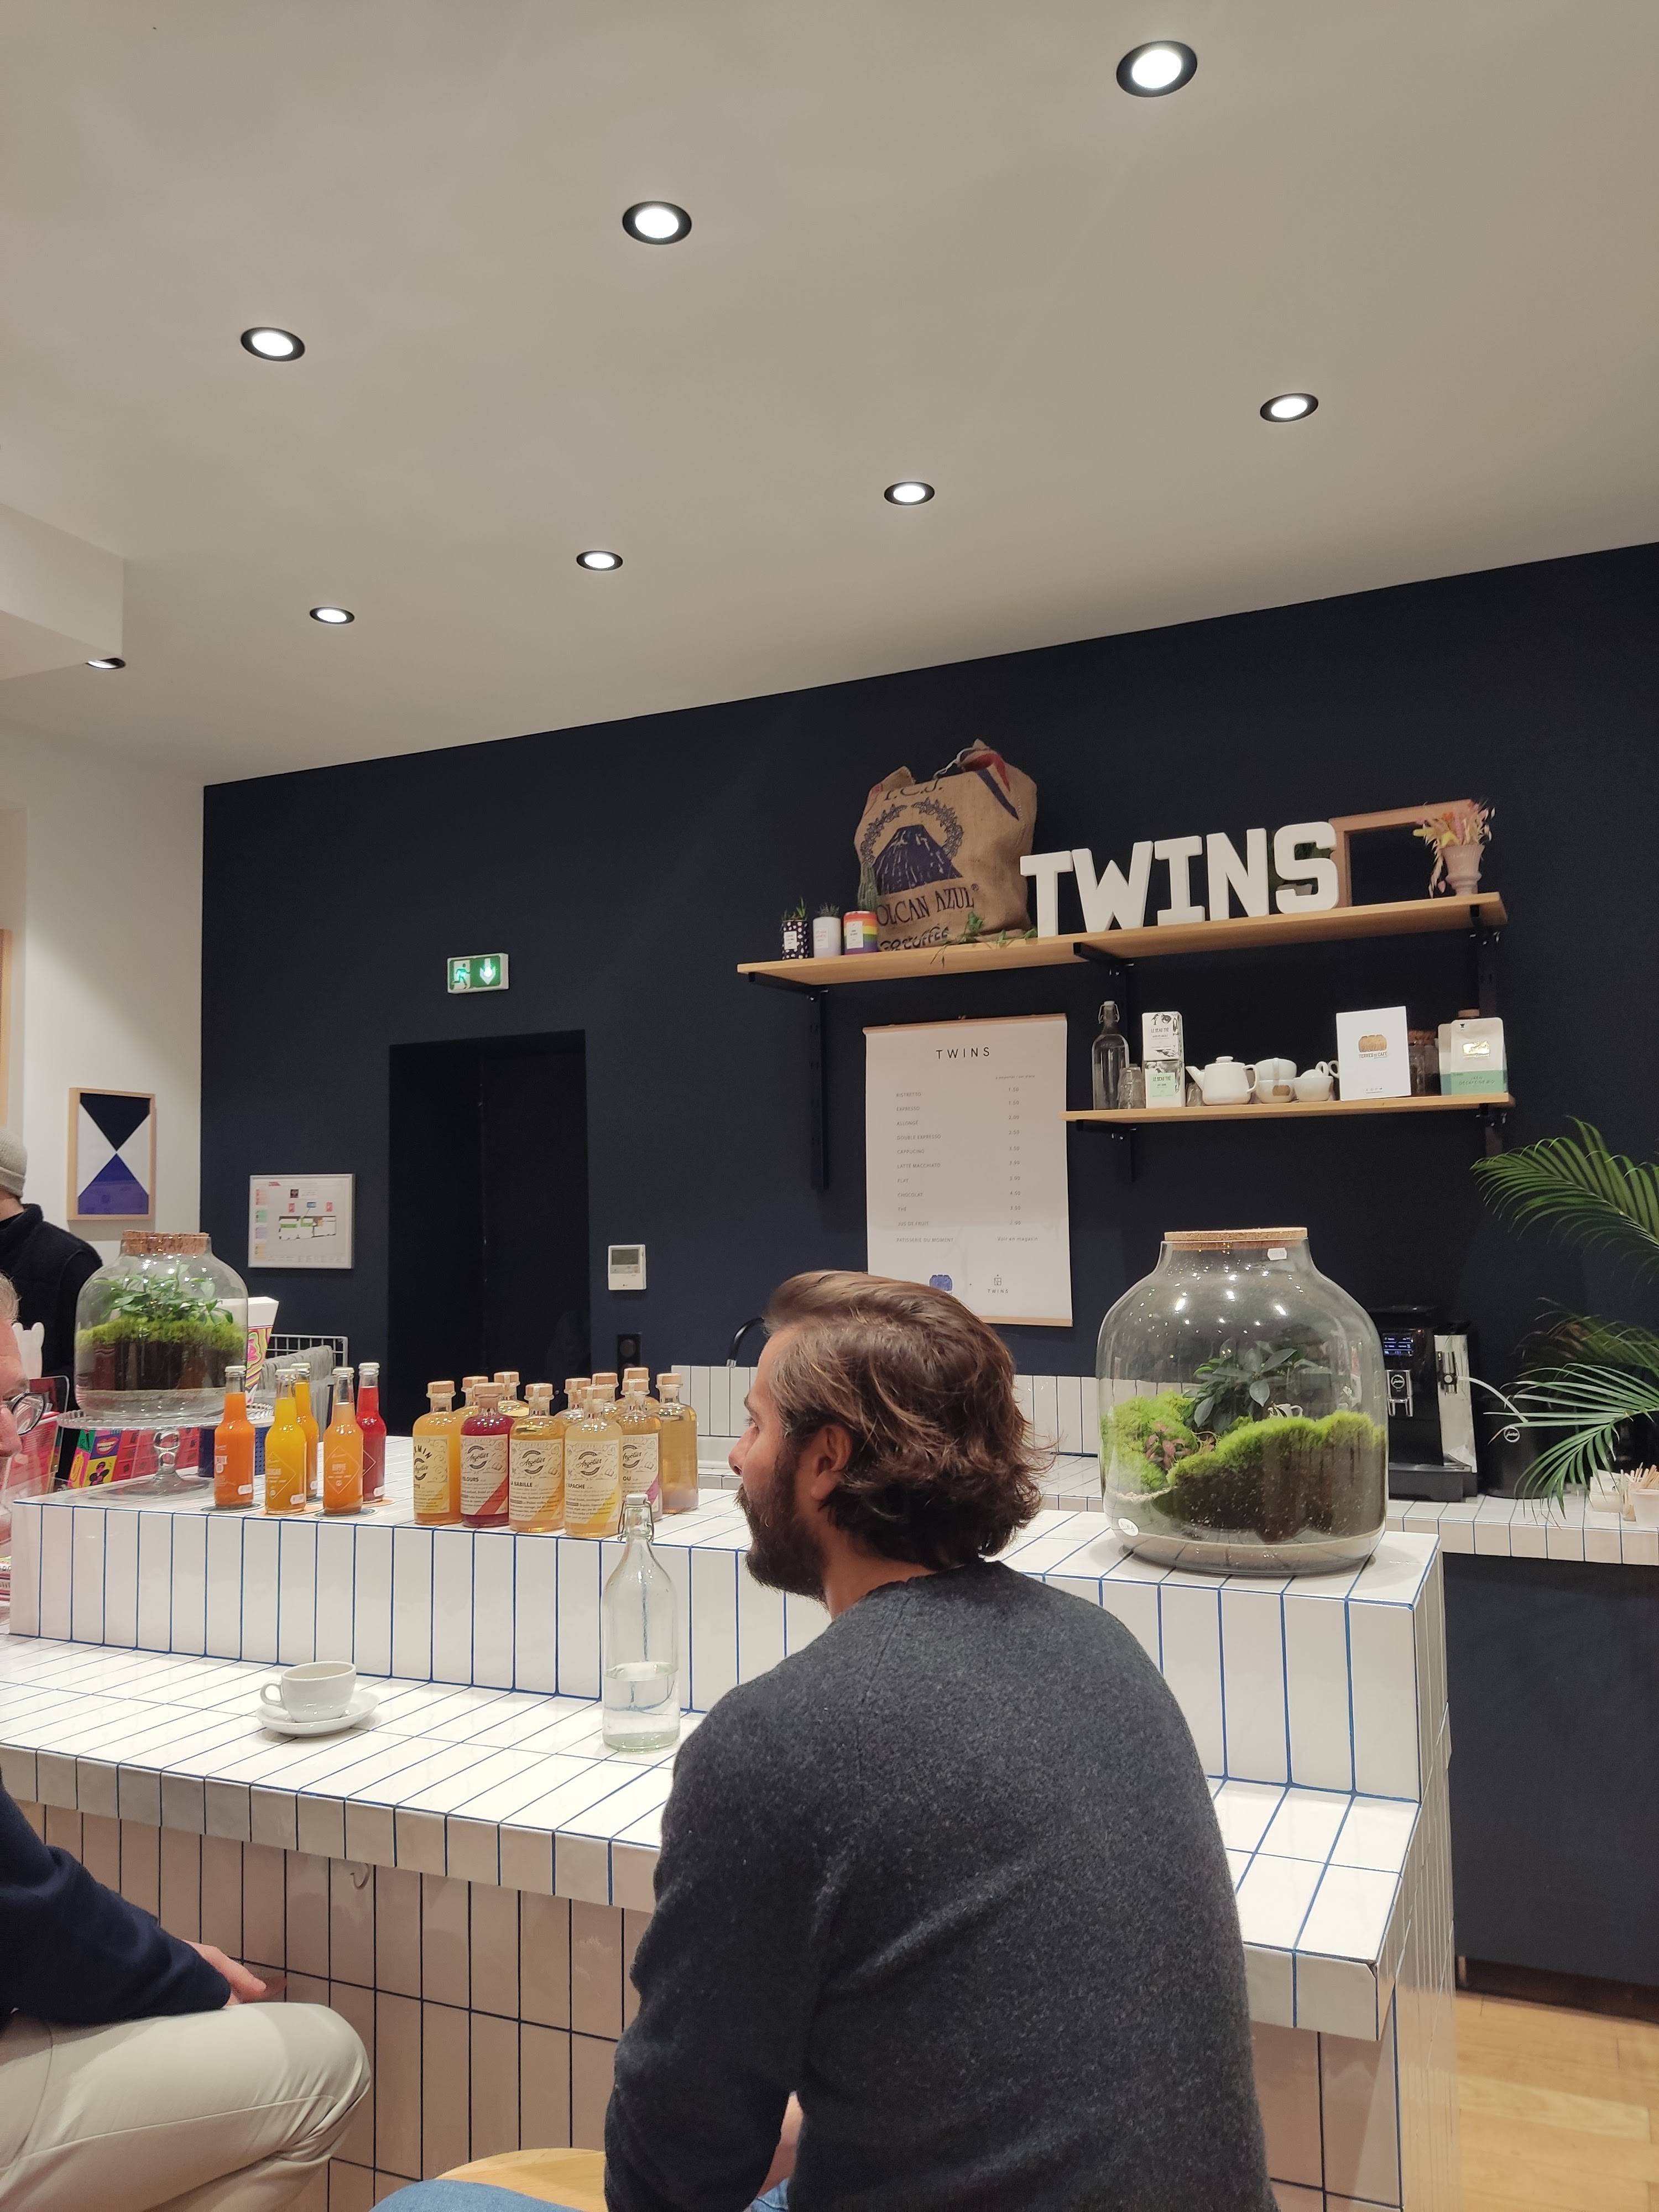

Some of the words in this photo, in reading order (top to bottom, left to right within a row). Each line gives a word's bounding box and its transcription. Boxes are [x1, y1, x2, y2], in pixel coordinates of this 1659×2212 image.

[1020, 822, 1339, 937] TWINS
[877, 895, 930, 926] OLCAN
[936, 1047, 990, 1060] TWINS
